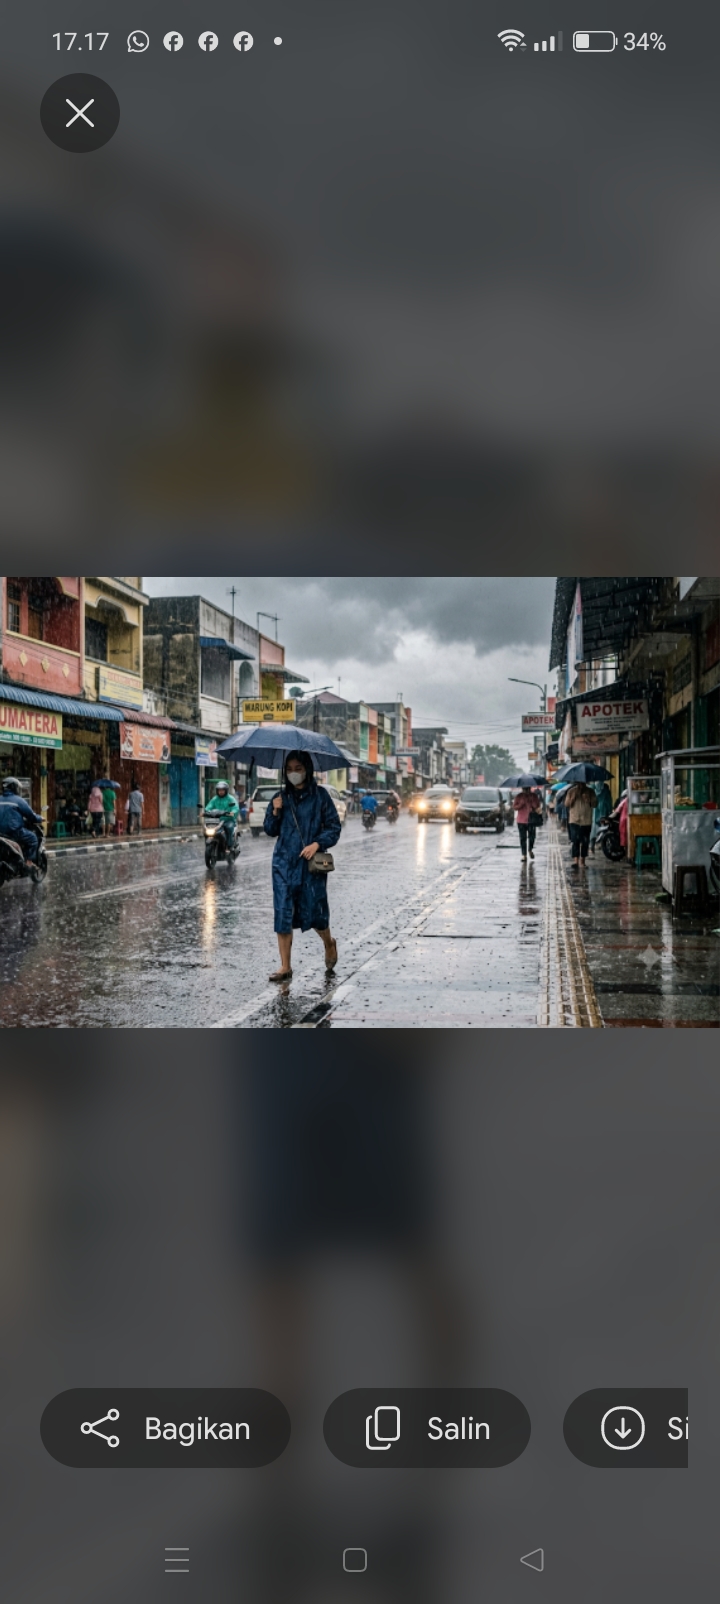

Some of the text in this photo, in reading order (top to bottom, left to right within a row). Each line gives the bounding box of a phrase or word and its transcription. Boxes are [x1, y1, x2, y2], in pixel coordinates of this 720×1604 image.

[244, 702, 293, 712] WARUNG KOPI
[581, 701, 644, 717] APOTEK
[0, 705, 58, 735] UMATERA
[523, 715, 555, 725] APOTEK
